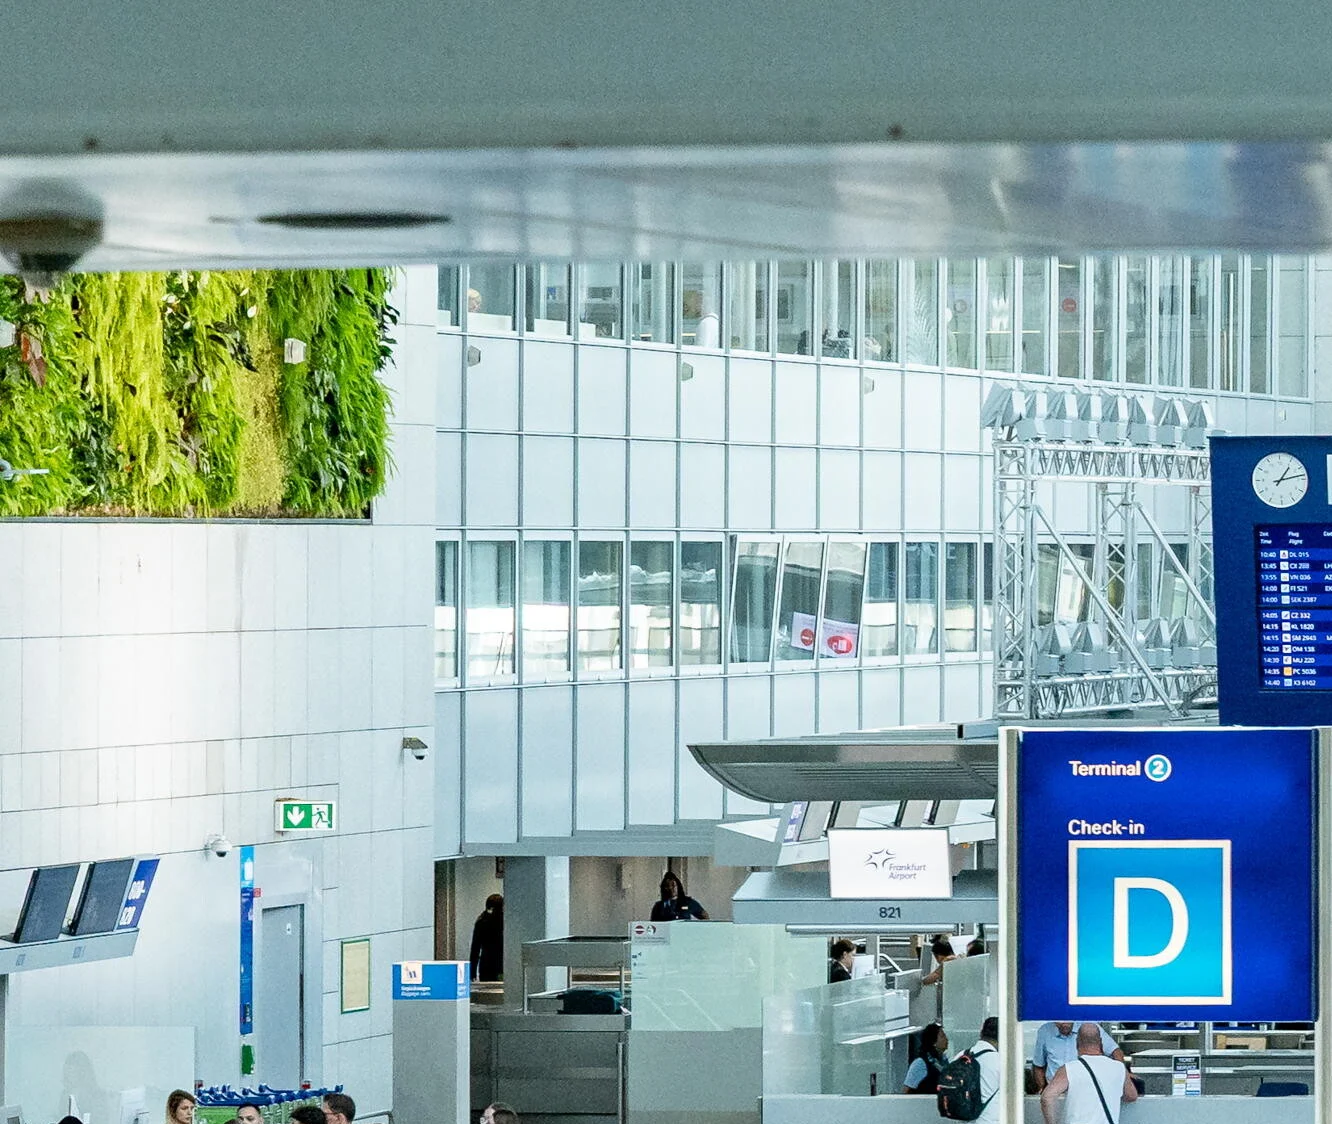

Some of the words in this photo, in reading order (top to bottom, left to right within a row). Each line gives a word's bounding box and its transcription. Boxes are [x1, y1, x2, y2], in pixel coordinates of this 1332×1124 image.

[1068, 760, 1141, 776] Terminal
[1153, 761, 1164, 775] 2
[1068, 819, 1145, 835] Check-in
[889, 864, 926, 872] Frankfurt
[889, 872, 917, 880] Airport
[879, 907, 901, 919] 821
[1114, 877, 1189, 968] D
